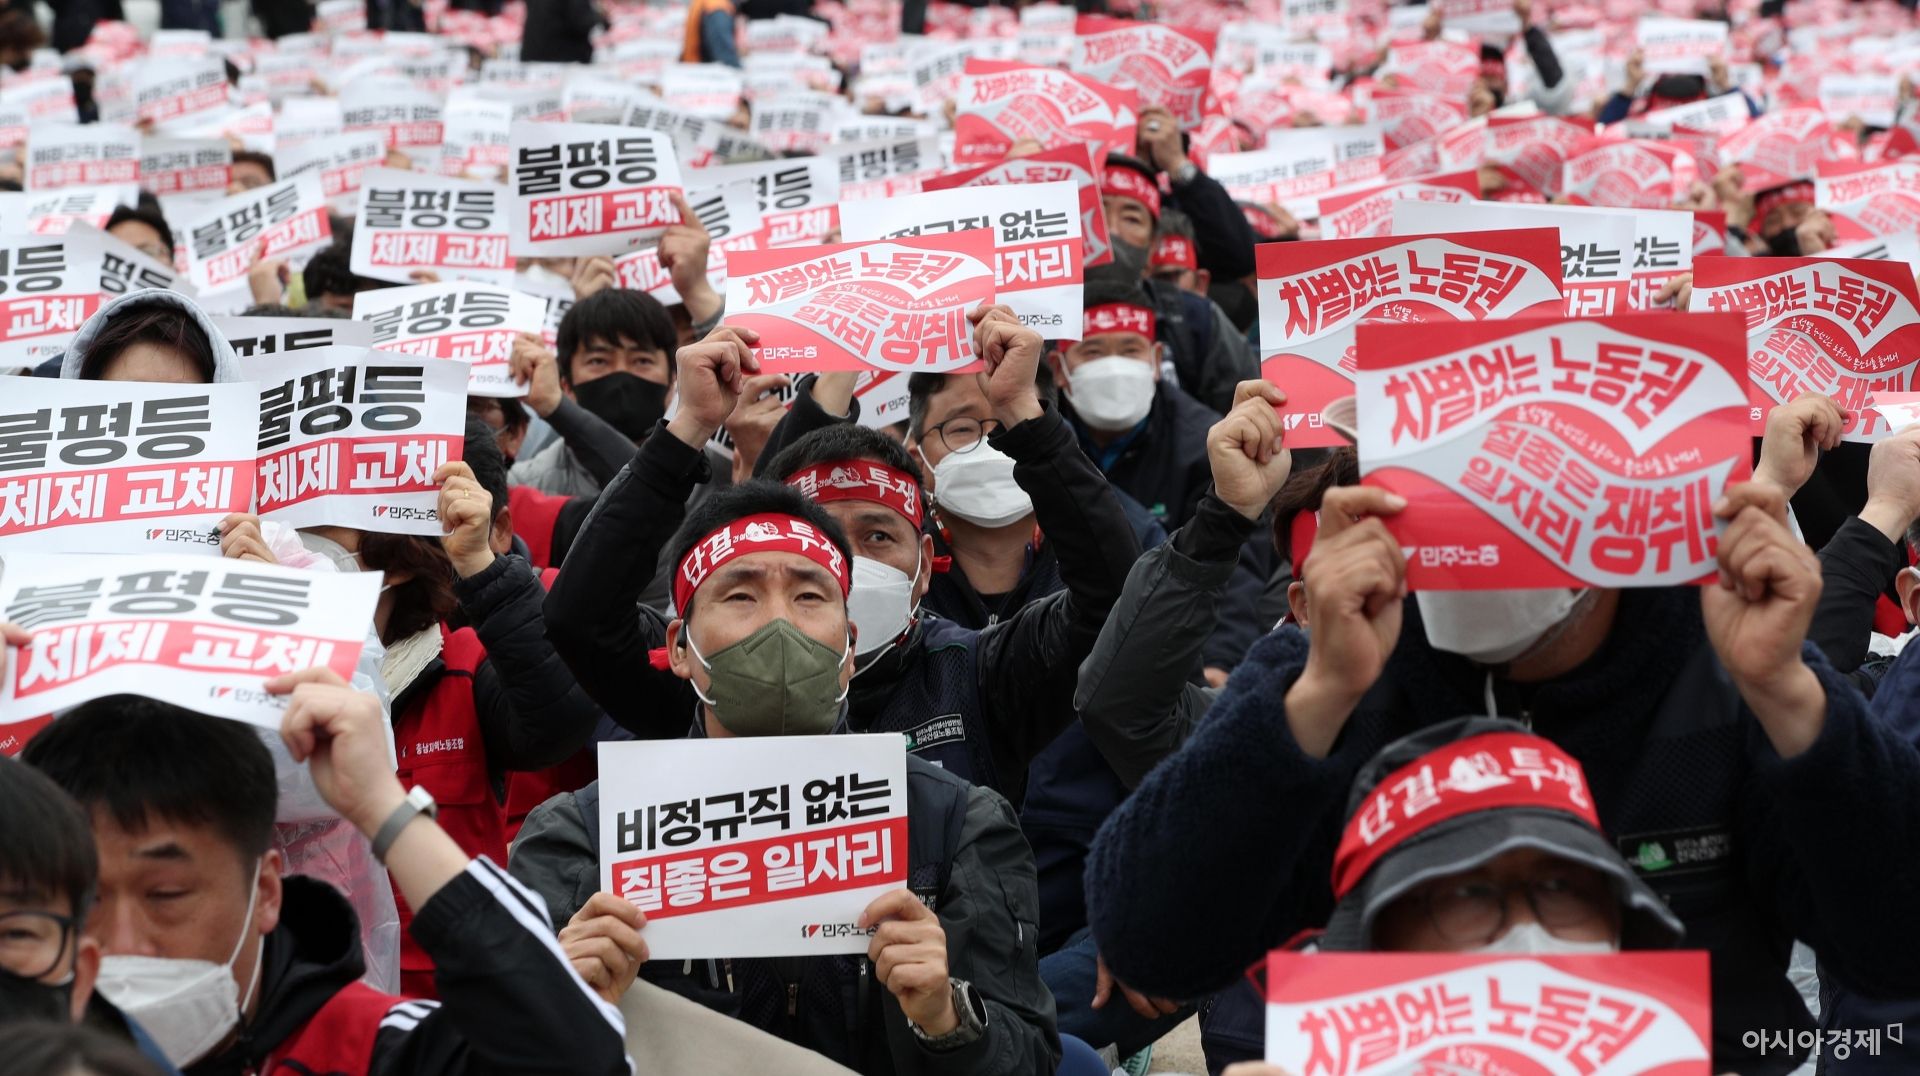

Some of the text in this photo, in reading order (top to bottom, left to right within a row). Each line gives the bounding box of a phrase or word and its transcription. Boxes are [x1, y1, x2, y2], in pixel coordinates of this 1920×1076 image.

[515, 138, 658, 196] 불평등
[192, 184, 300, 260] 불평등
[365, 189, 494, 230] 불평등
[531, 190, 681, 239] 체제 교체
[768, 209, 831, 245] 교체
[999, 208, 1069, 243] 없는
[373, 234, 507, 269] 체제 교체
[746, 251, 966, 306] 차별없는 노동권
[7, 297, 84, 338] 교체
[362, 292, 510, 346] 불평등
[813, 291, 890, 328] 질좋은
[1279, 249, 1528, 341] 차별없는 노동권
[1708, 270, 1898, 340] 차별없는 노동권
[762, 346, 818, 360] 민주노총
[793, 305, 876, 359] 일자리
[880, 307, 974, 365] 쟁취!
[1763, 329, 1838, 392] 질좋은
[257, 365, 426, 451] 불평등
[1384, 336, 1705, 447] 차별없는 노동권
[0, 395, 212, 472] 불평등
[0, 466, 236, 529] 체제 교체
[257, 440, 448, 505] 체제 교체
[865, 466, 917, 517] 투쟁
[1481, 422, 1601, 513] 질좋은
[165, 528, 222, 547] 민주노총
[389, 505, 439, 523] 민주노총
[1459, 455, 1583, 567] 일자리
[1589, 474, 1719, 577] 쟁취!
[682, 526, 736, 589] 단결
[786, 519, 843, 578] 투쟁
[1418, 544, 1501, 568] 민주노총
[4, 570, 313, 632] 불평등
[20, 622, 334, 690] 체제 교체
[617, 773, 892, 854] 비정규직 없는
[1358, 746, 1590, 847] 단결 투쟁
[621, 827, 893, 913] 질좋은 일자리
[1298, 975, 1659, 1076] 차별없는 노동권
